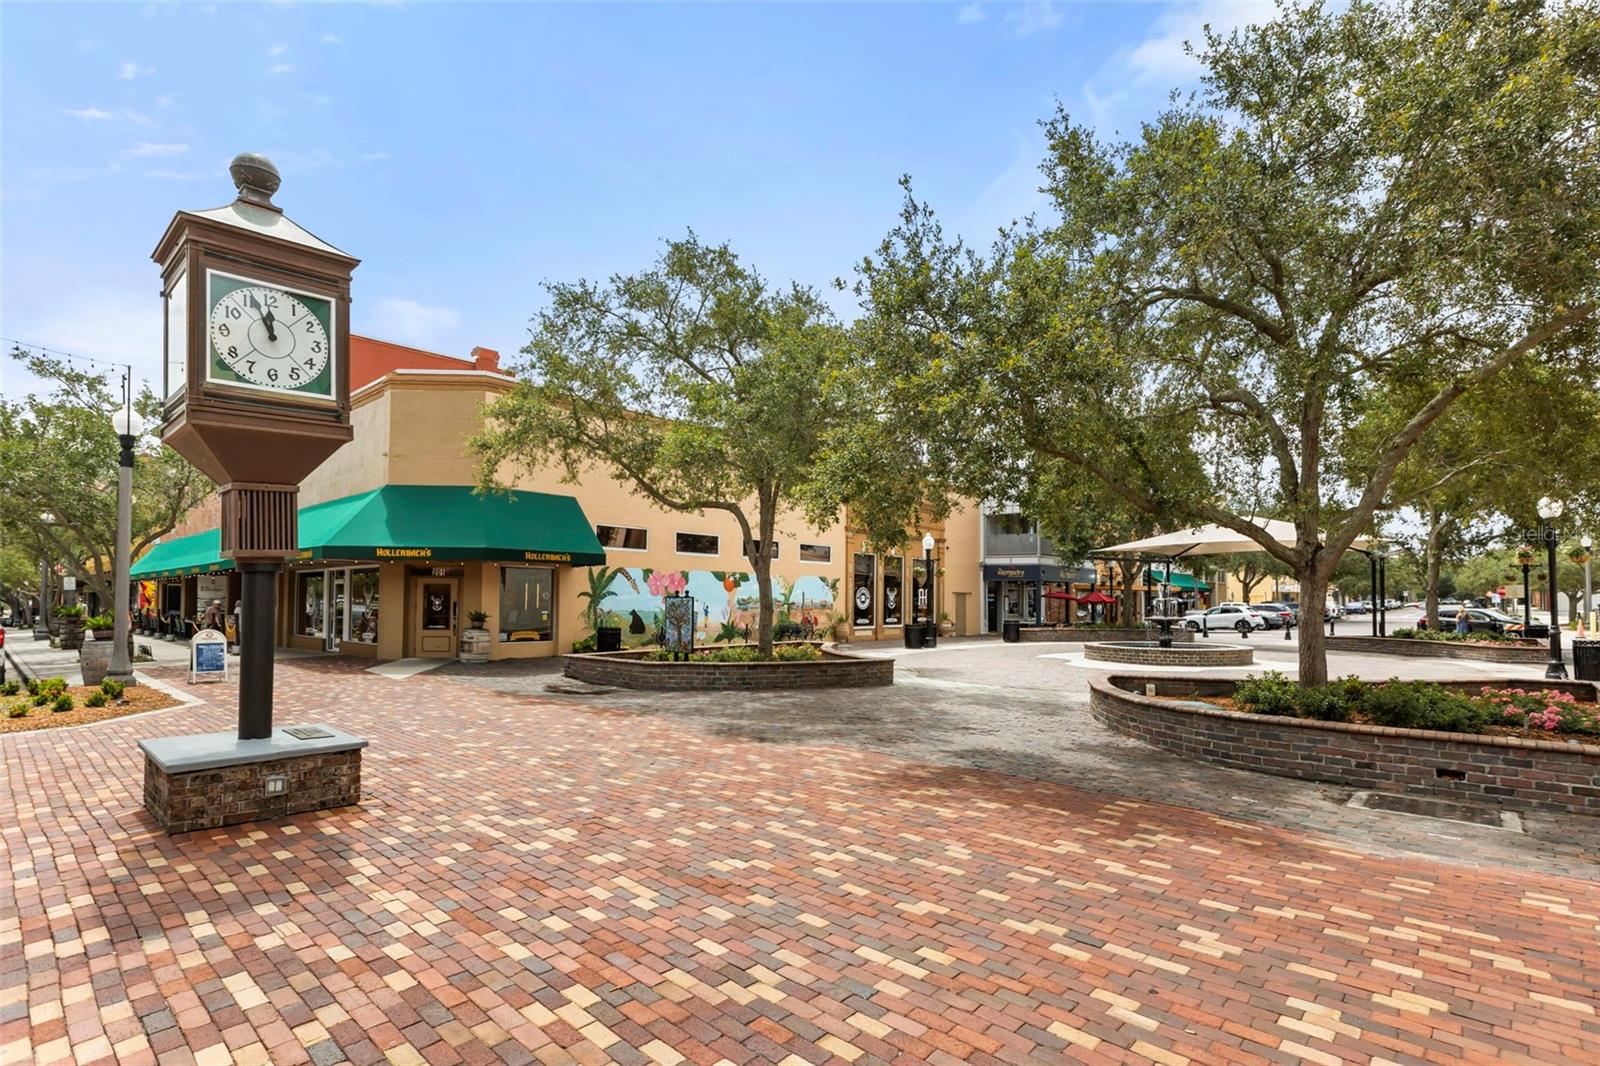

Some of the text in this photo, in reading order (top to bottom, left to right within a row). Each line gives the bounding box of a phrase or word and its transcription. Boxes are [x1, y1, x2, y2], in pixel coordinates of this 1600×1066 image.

[264, 293, 279, 309] 12
[225, 305, 242, 320] 10
[291, 304, 296, 317] 1
[218, 323, 230, 337] 9
[305, 320, 315, 334] 2
[227, 345, 239, 359] 8
[311, 340, 321, 354] 3
[245, 360, 256, 374] 7
[303, 357, 316, 370] 4
[267, 368, 279, 382] 6
[288, 366, 300, 381] 5
